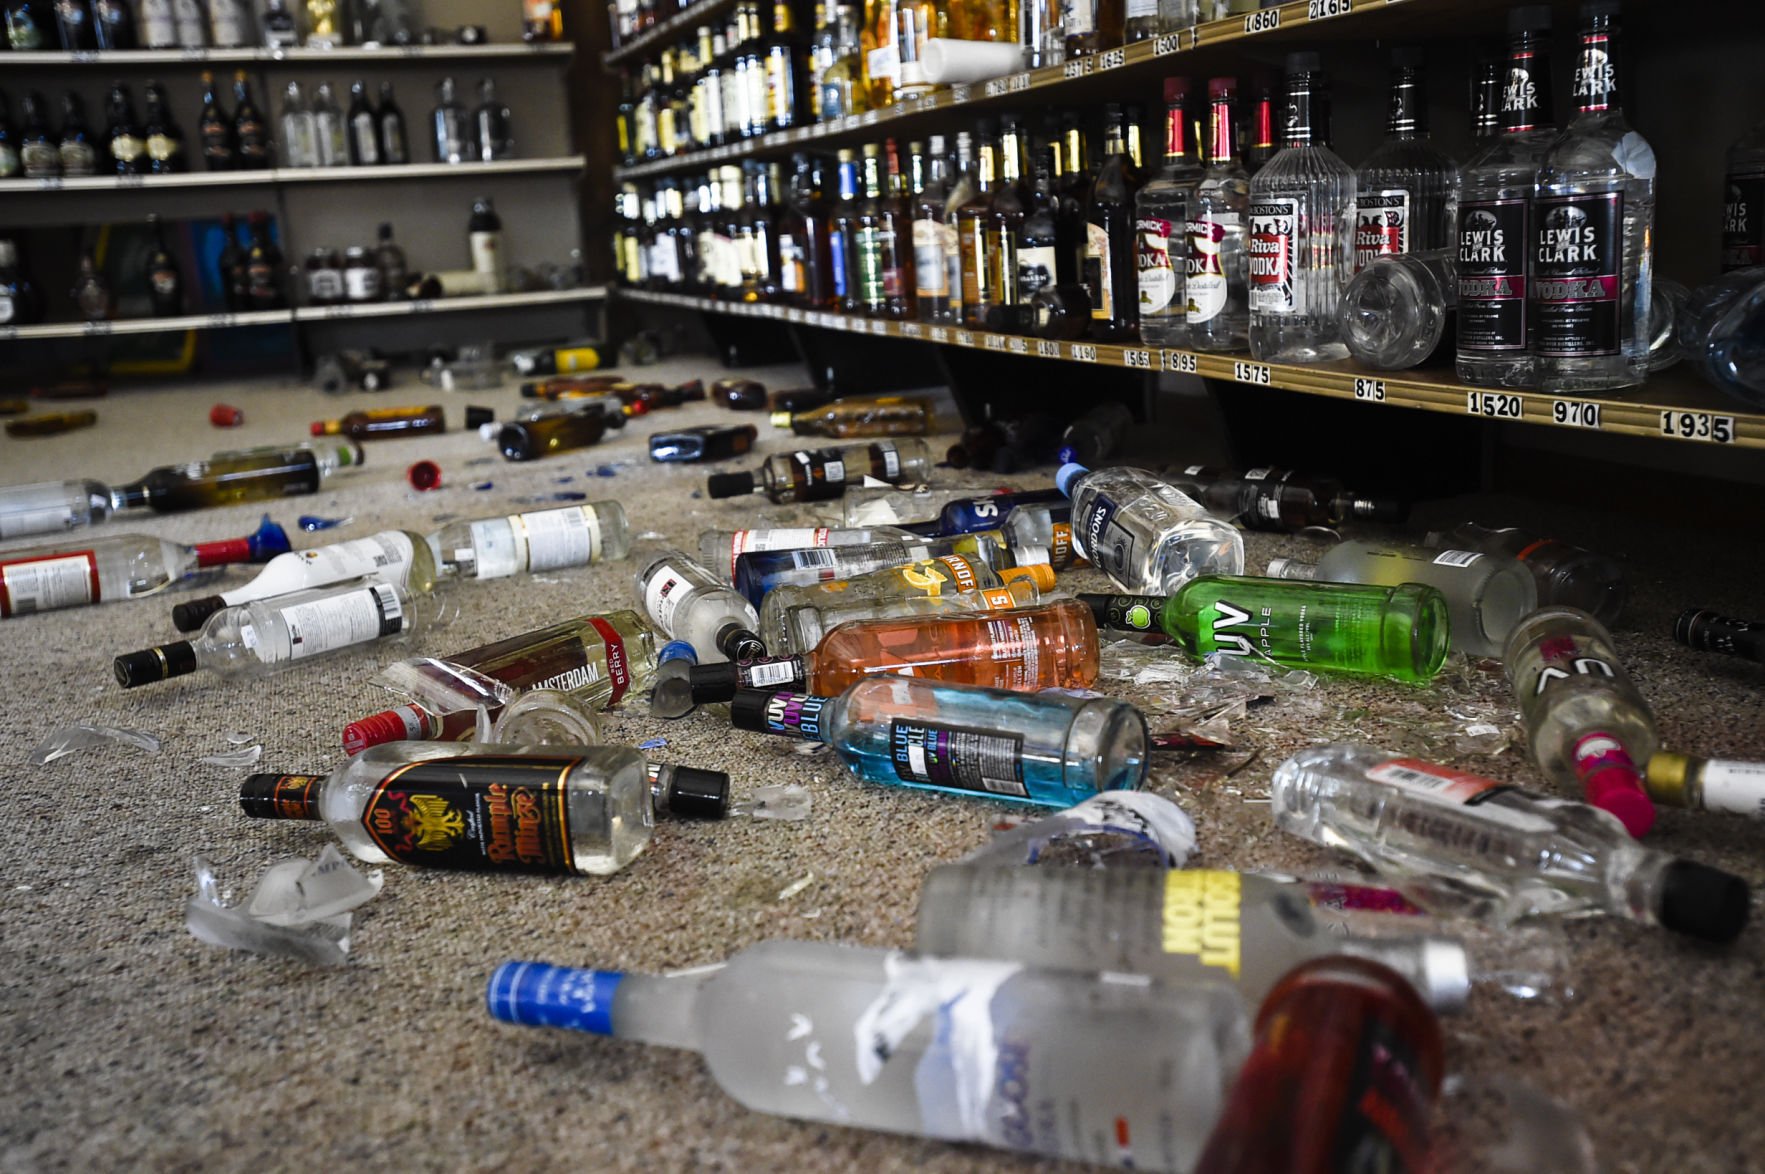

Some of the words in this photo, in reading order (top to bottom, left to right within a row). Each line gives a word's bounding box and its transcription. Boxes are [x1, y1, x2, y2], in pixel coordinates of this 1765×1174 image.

[1310, 0, 1350, 20] 2165
[1246, 11, 1277, 32] 1860
[1251, 238, 1279, 253] Riva
[1357, 231, 1390, 245] Riva
[1460, 229, 1504, 246] LEWIS
[1540, 226, 1596, 245] LEWIS
[1459, 245, 1506, 263] CLARK
[1539, 244, 1598, 263] CLARK
[1459, 279, 1512, 297] VODKA
[1537, 279, 1605, 299] VODKA
[1172, 352, 1196, 371] 895
[1236, 363, 1269, 384] 1575
[1356, 378, 1385, 401] 875
[1470, 392, 1521, 418] 1520
[1554, 400, 1596, 426] 970
[1663, 412, 1731, 443] 1935
[1213, 600, 1250, 656] UV
[1260, 607, 1272, 656] APPLE
[611, 644, 625, 685] BERRY
[895, 724, 909, 762] BLUE
[374, 808, 393, 834] 100
[484, 783, 516, 864] Rumple
